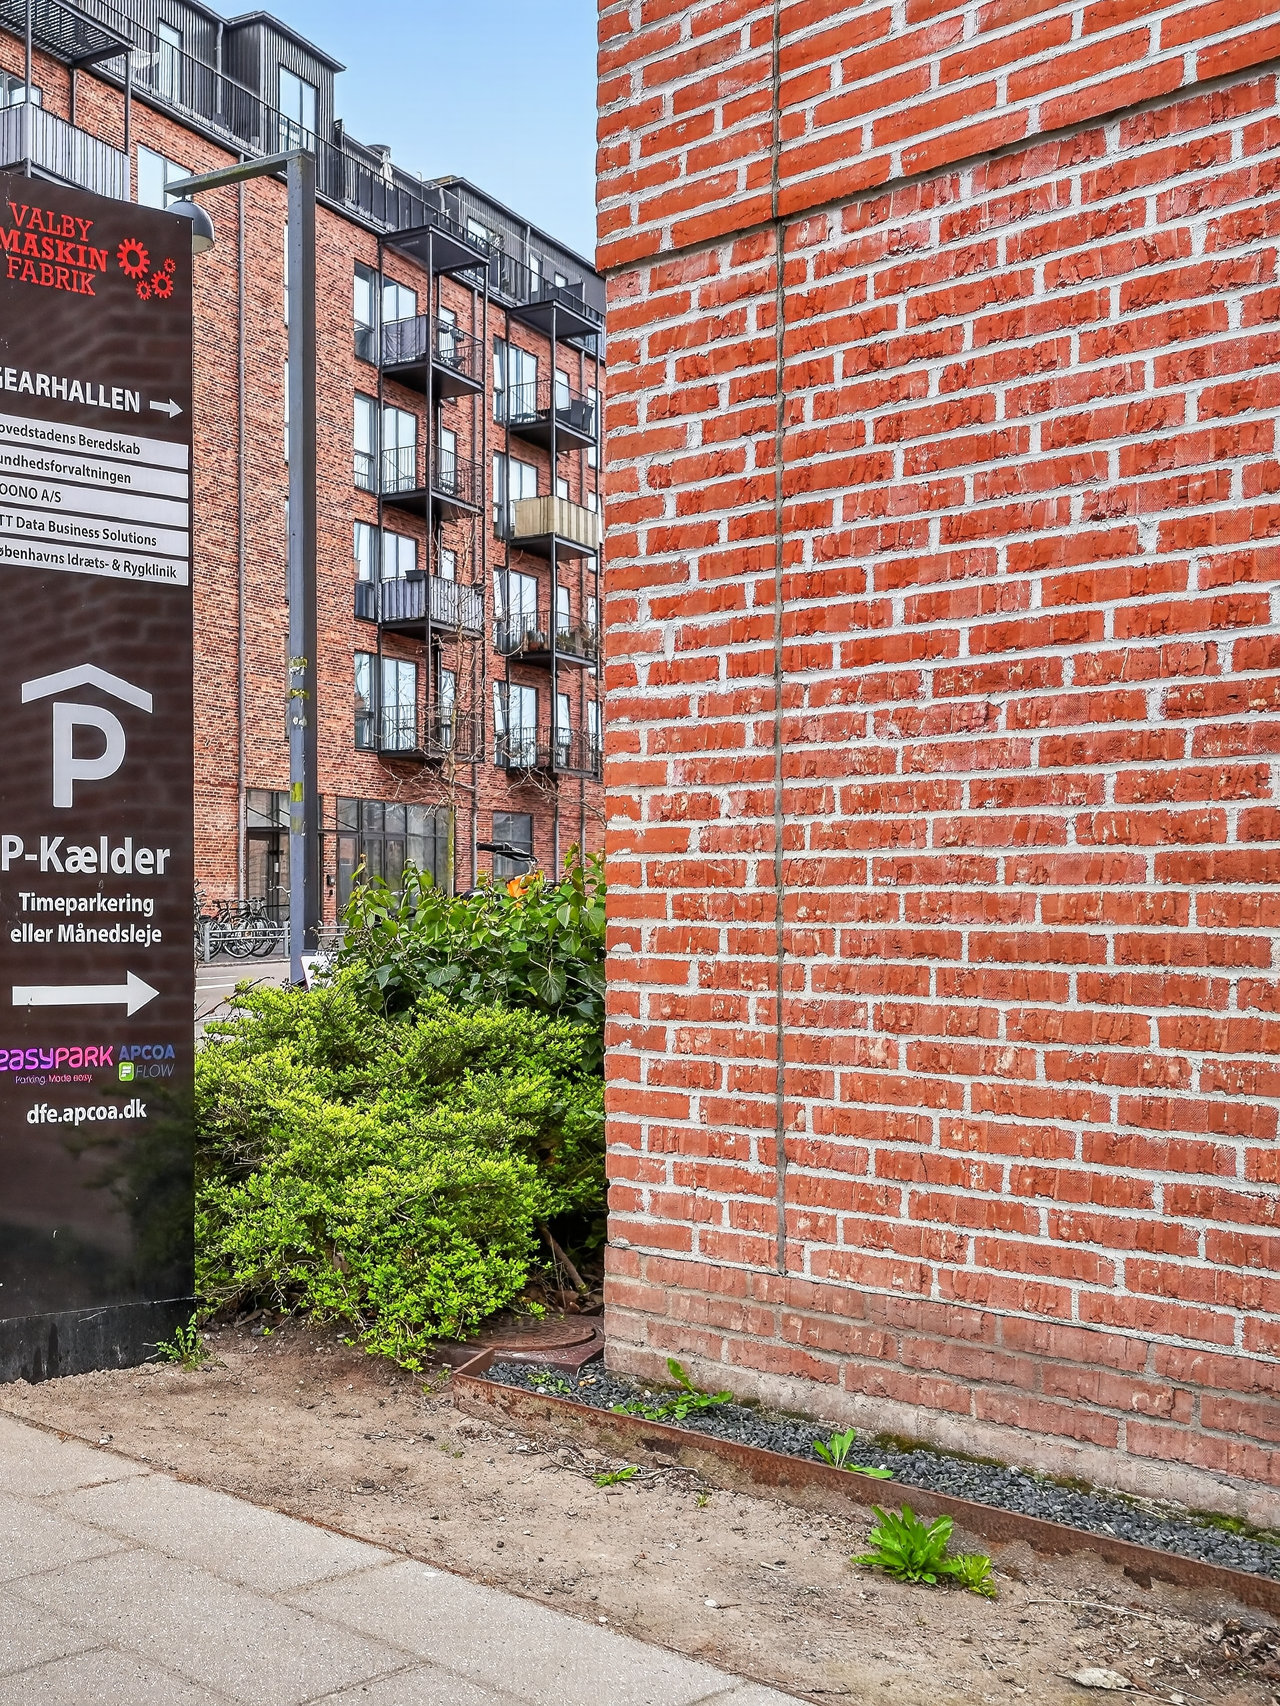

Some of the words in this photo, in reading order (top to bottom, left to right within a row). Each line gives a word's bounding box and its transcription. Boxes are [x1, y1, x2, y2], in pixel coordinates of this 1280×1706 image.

[9, 202, 93, 242] VALBY
[6, 256, 96, 296] FABRIK
[78, 434, 140, 455] Beredskab
[41, 489, 62, 503] A/S
[16, 516, 45, 531] Data
[49, 521, 100, 539] Business
[102, 529, 157, 546] Solutions
[67, 554, 110, 570] Idræts-
[112, 559, 121, 571] &
[123, 561, 177, 579] Rygklinik
[53, 702, 126, 808] P
[1, 835, 170, 875] P-Kælder
[19, 892, 154, 918] Timeparkering
[10, 924, 53, 943] eller
[57, 922, 162, 947] Månedsleje
[118, 1044, 176, 1061] APCOA
[48, 1073, 71, 1083] Made
[135, 1064, 175, 1079] FLOW
[26, 1098, 147, 1127] dfe.apcoa.dk
